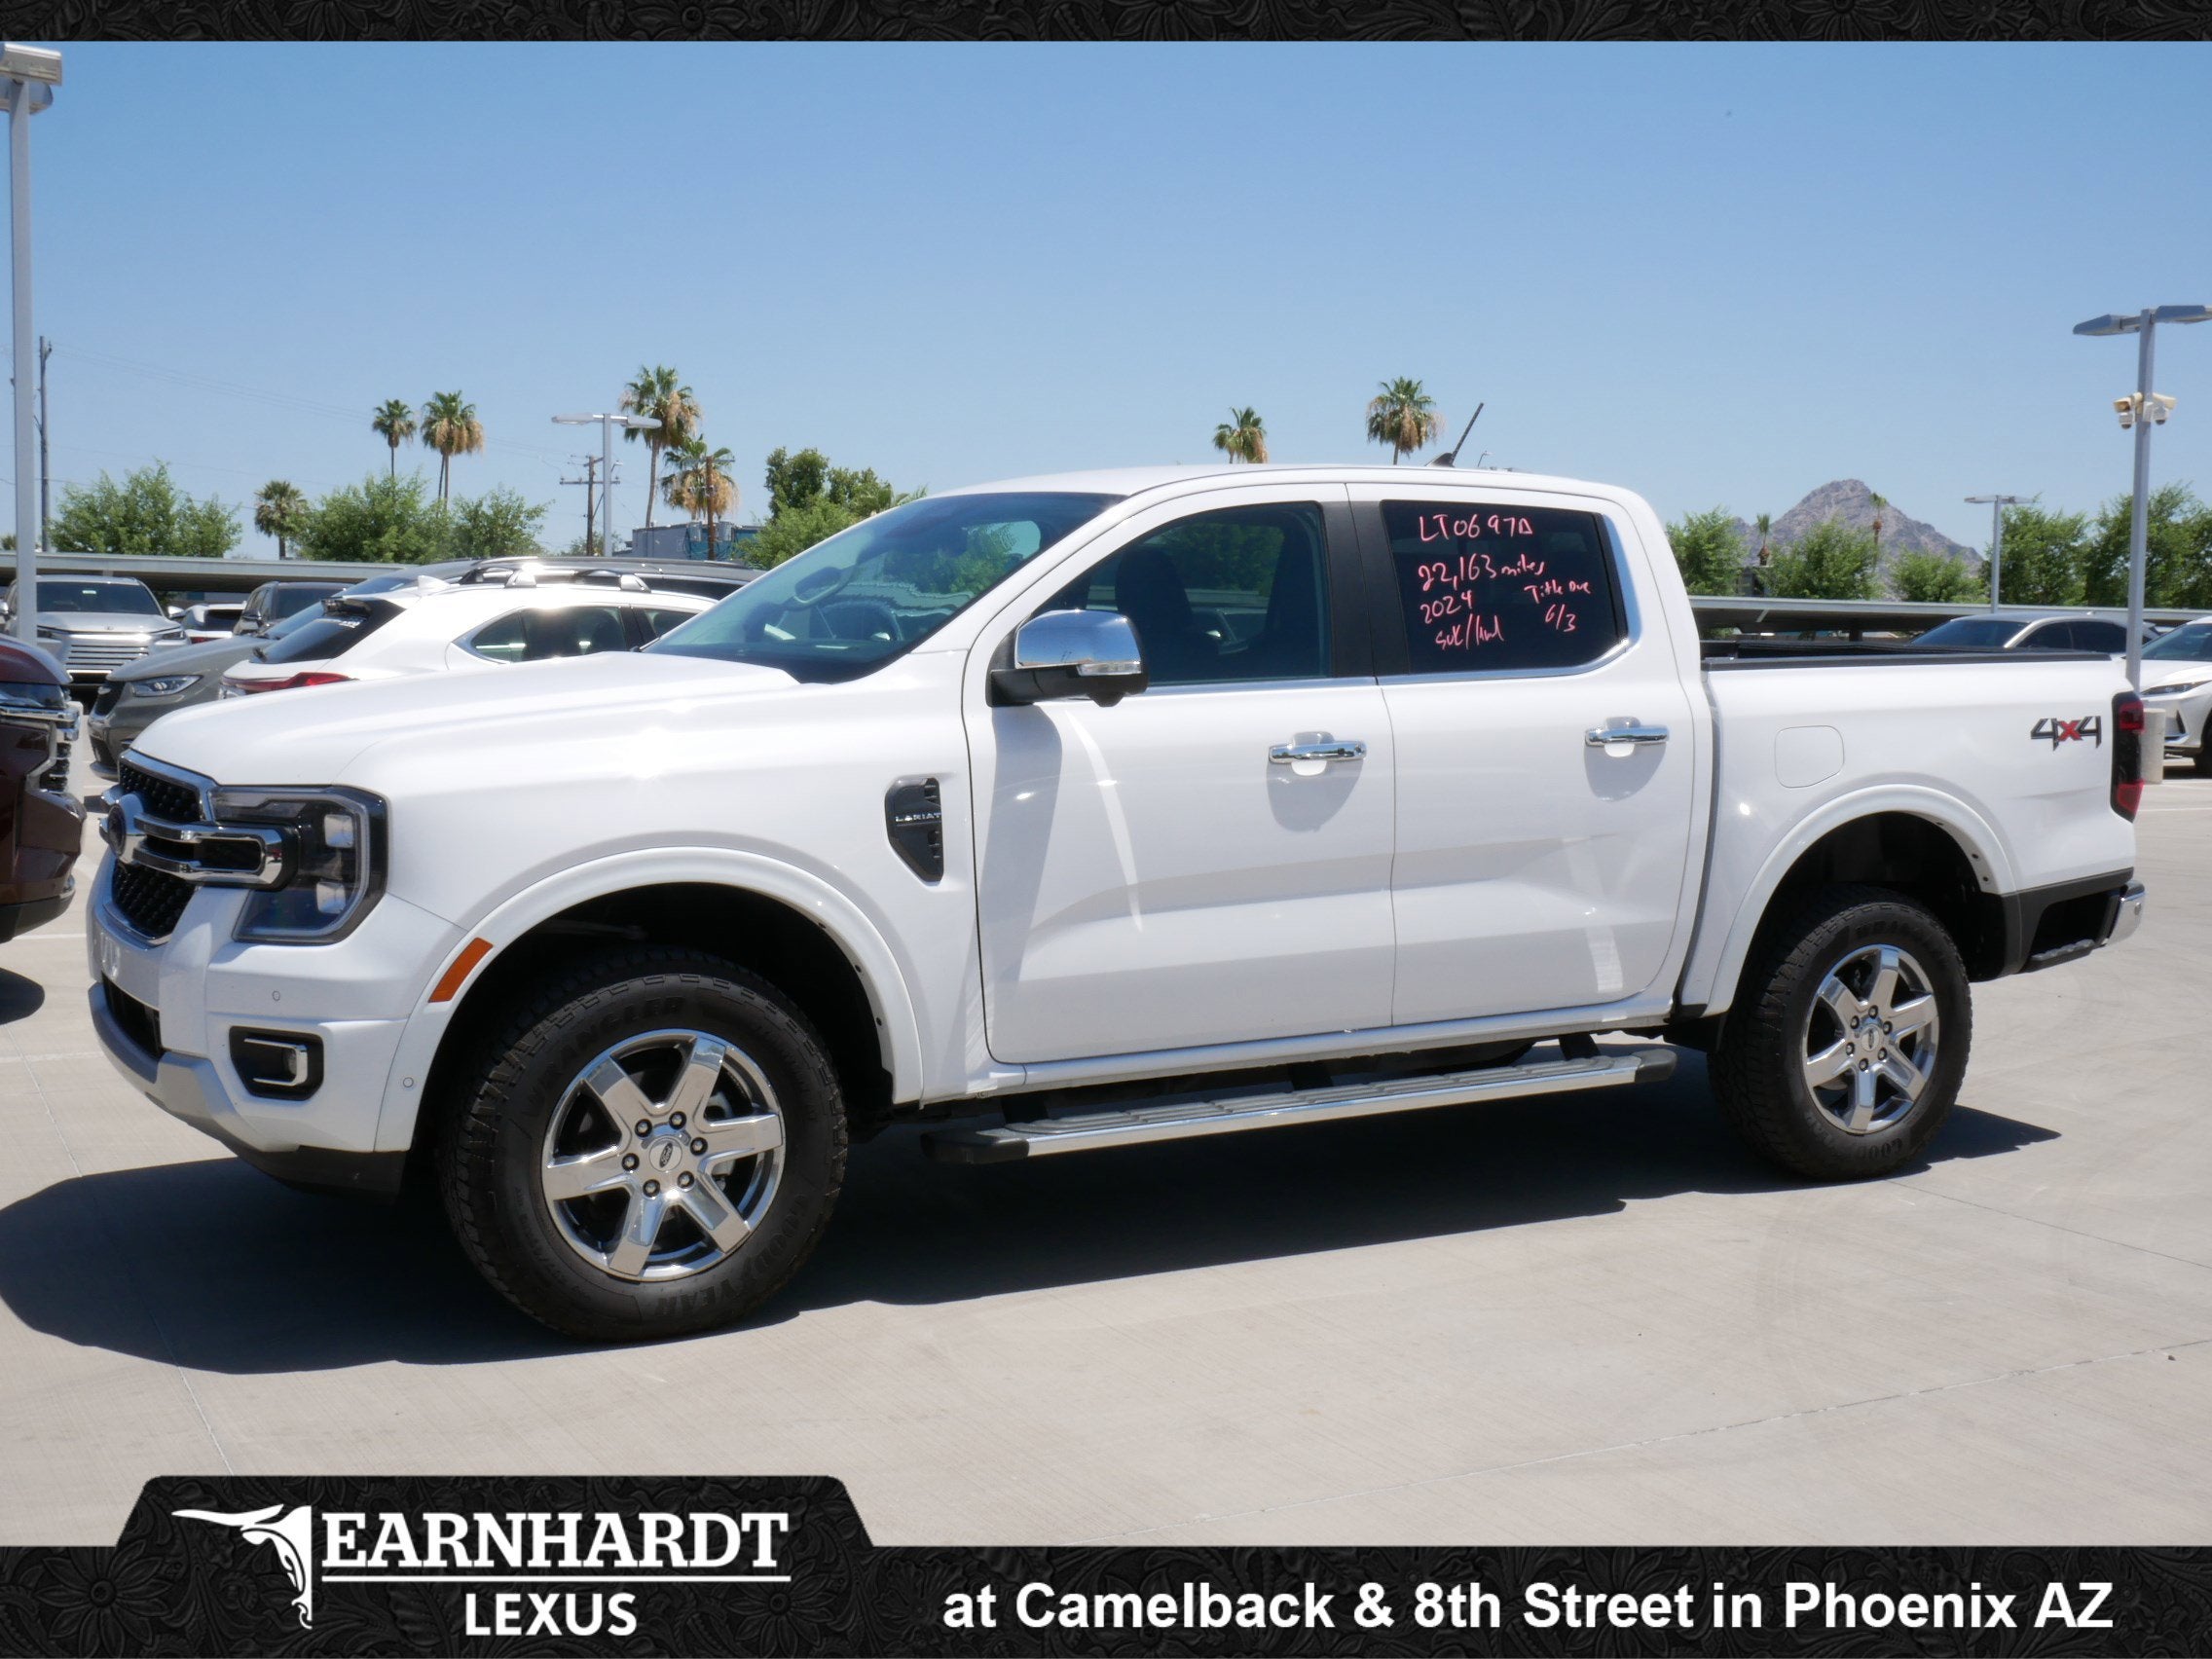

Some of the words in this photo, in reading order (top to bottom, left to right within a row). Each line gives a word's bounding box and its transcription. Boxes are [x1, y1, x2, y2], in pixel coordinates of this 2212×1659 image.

[1419, 589, 1472, 624] 2024
[1544, 604, 1576, 632] 6/3
[895, 812, 941, 822] LARIAT
